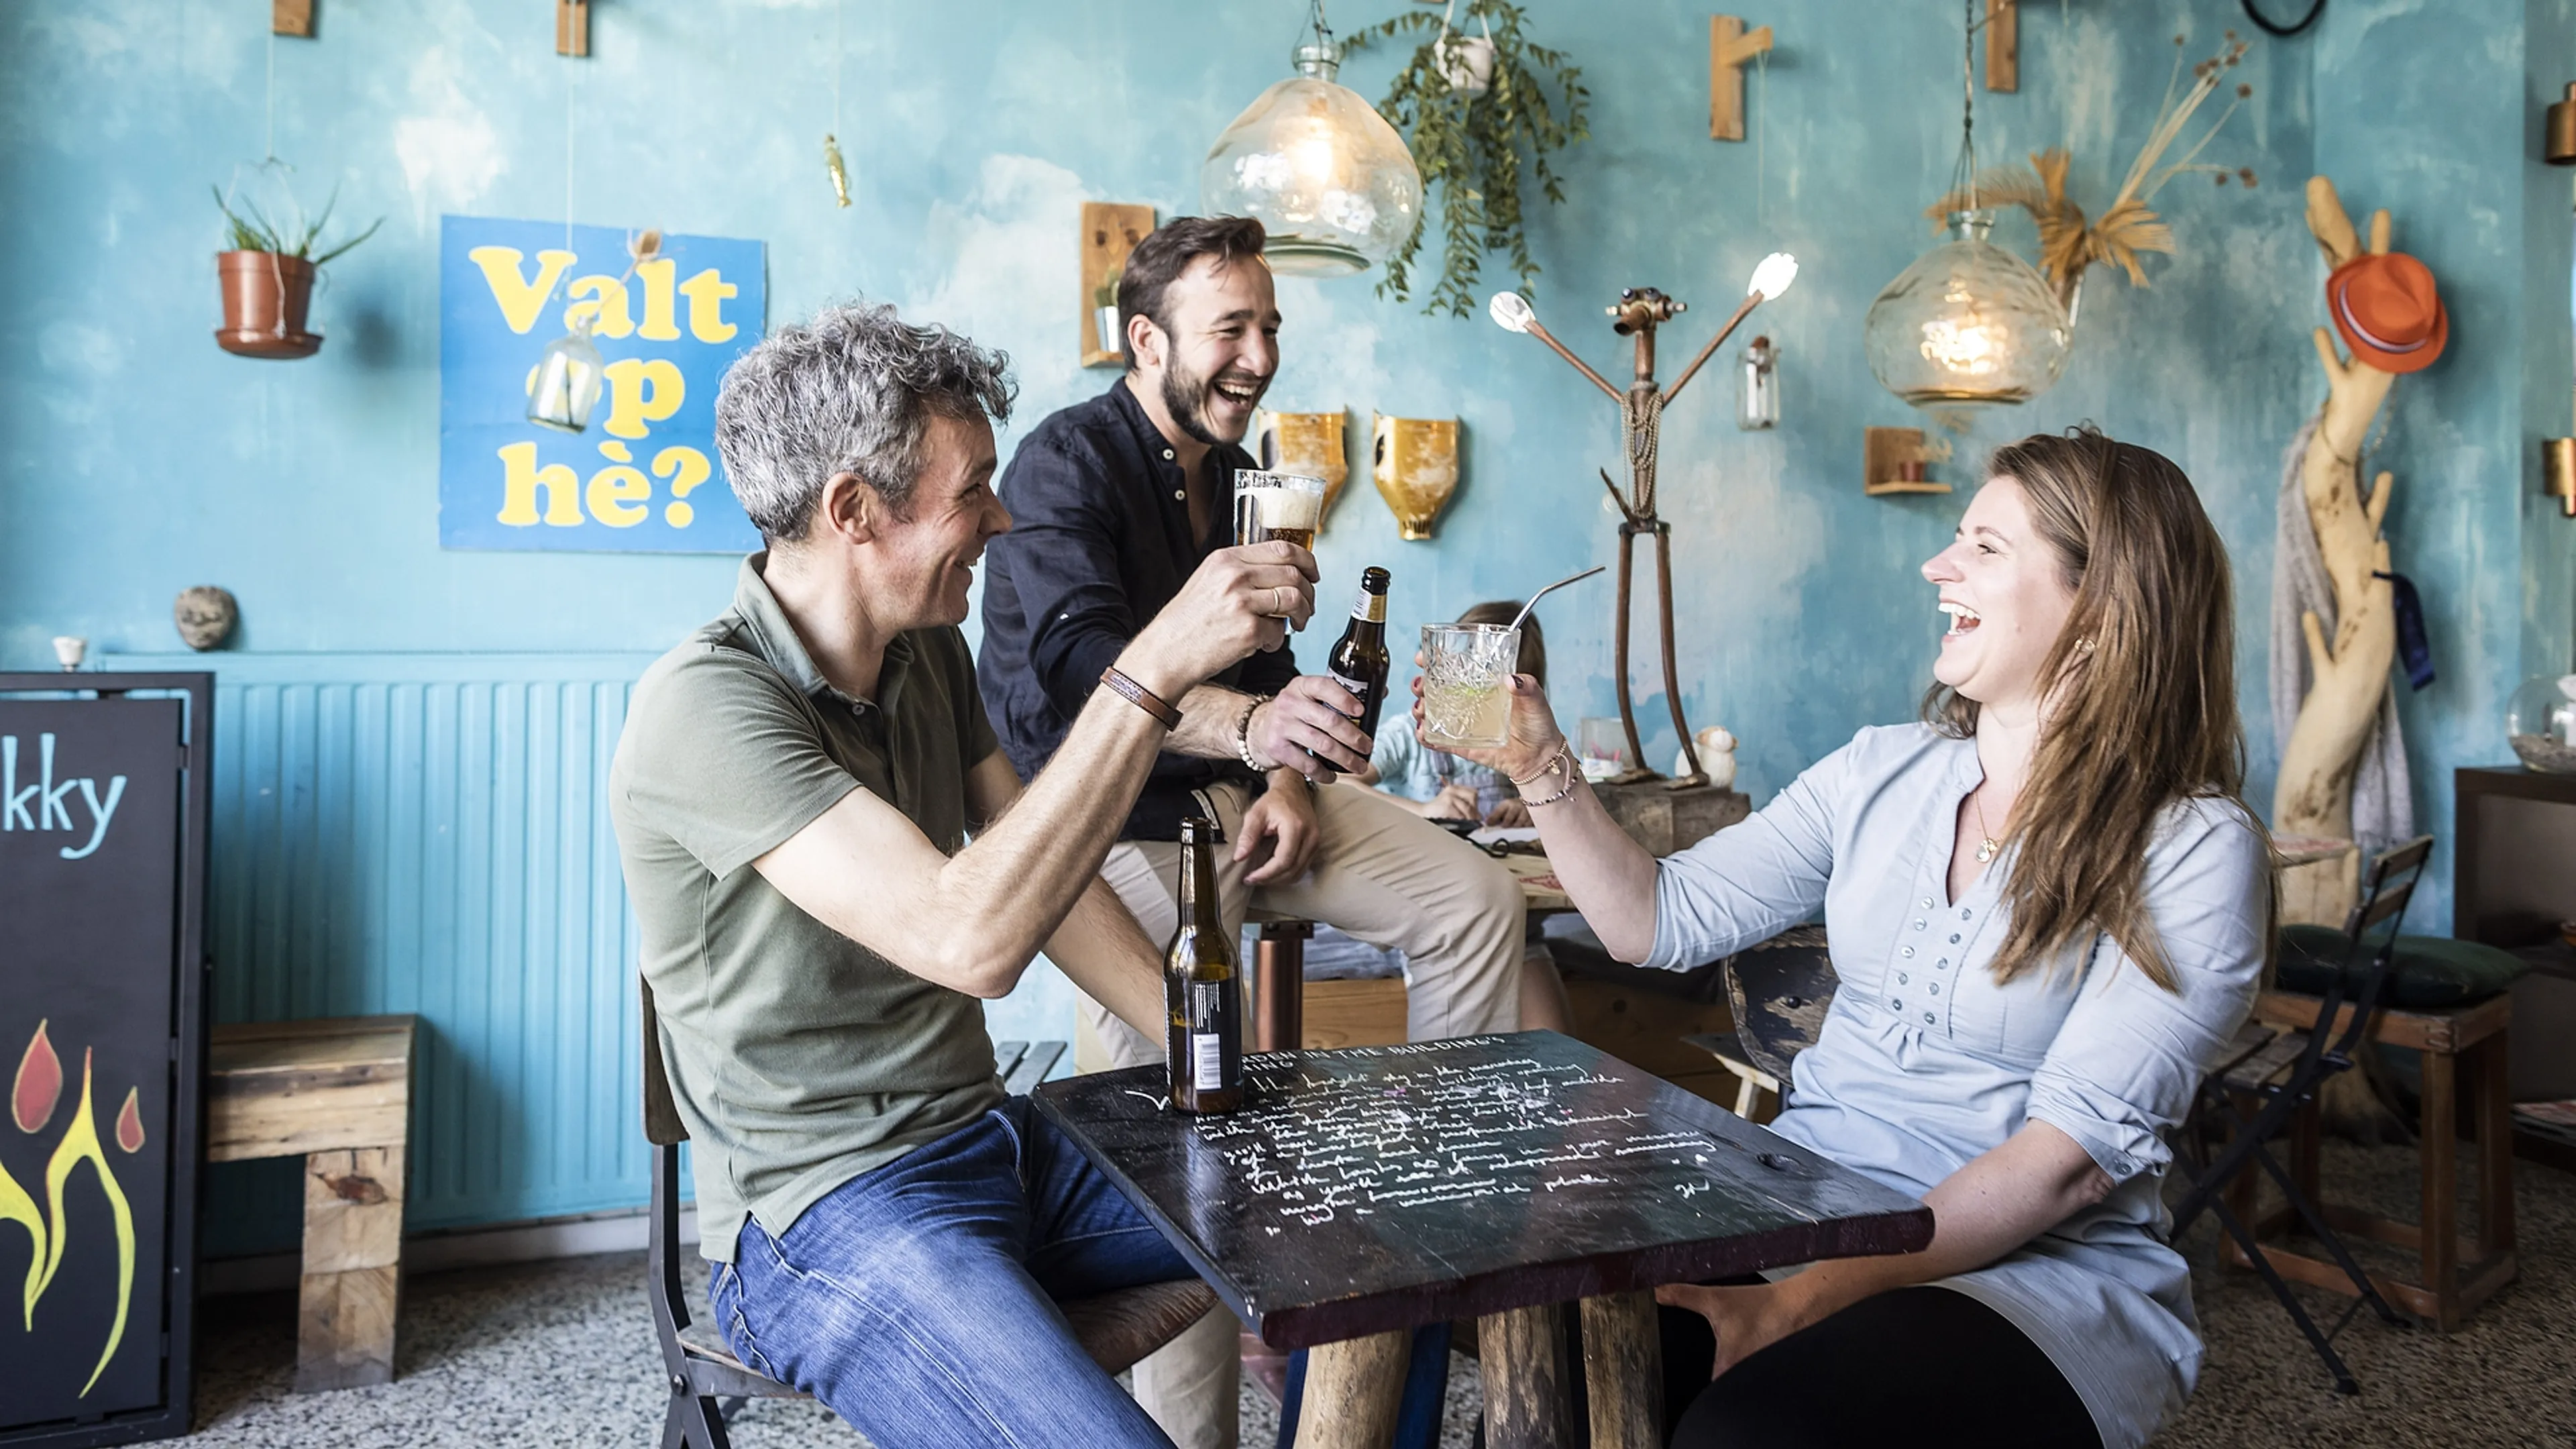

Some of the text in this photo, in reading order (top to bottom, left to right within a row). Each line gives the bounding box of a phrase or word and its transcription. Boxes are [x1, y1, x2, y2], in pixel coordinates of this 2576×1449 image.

[468, 246, 738, 344] Valt
[496, 440, 711, 529] hè?
[1, 733, 127, 859] kky
[1241, 1036, 1505, 1064] RDEN IN THE BUILDING'S
[1242, 1060, 1293, 1073] NING
